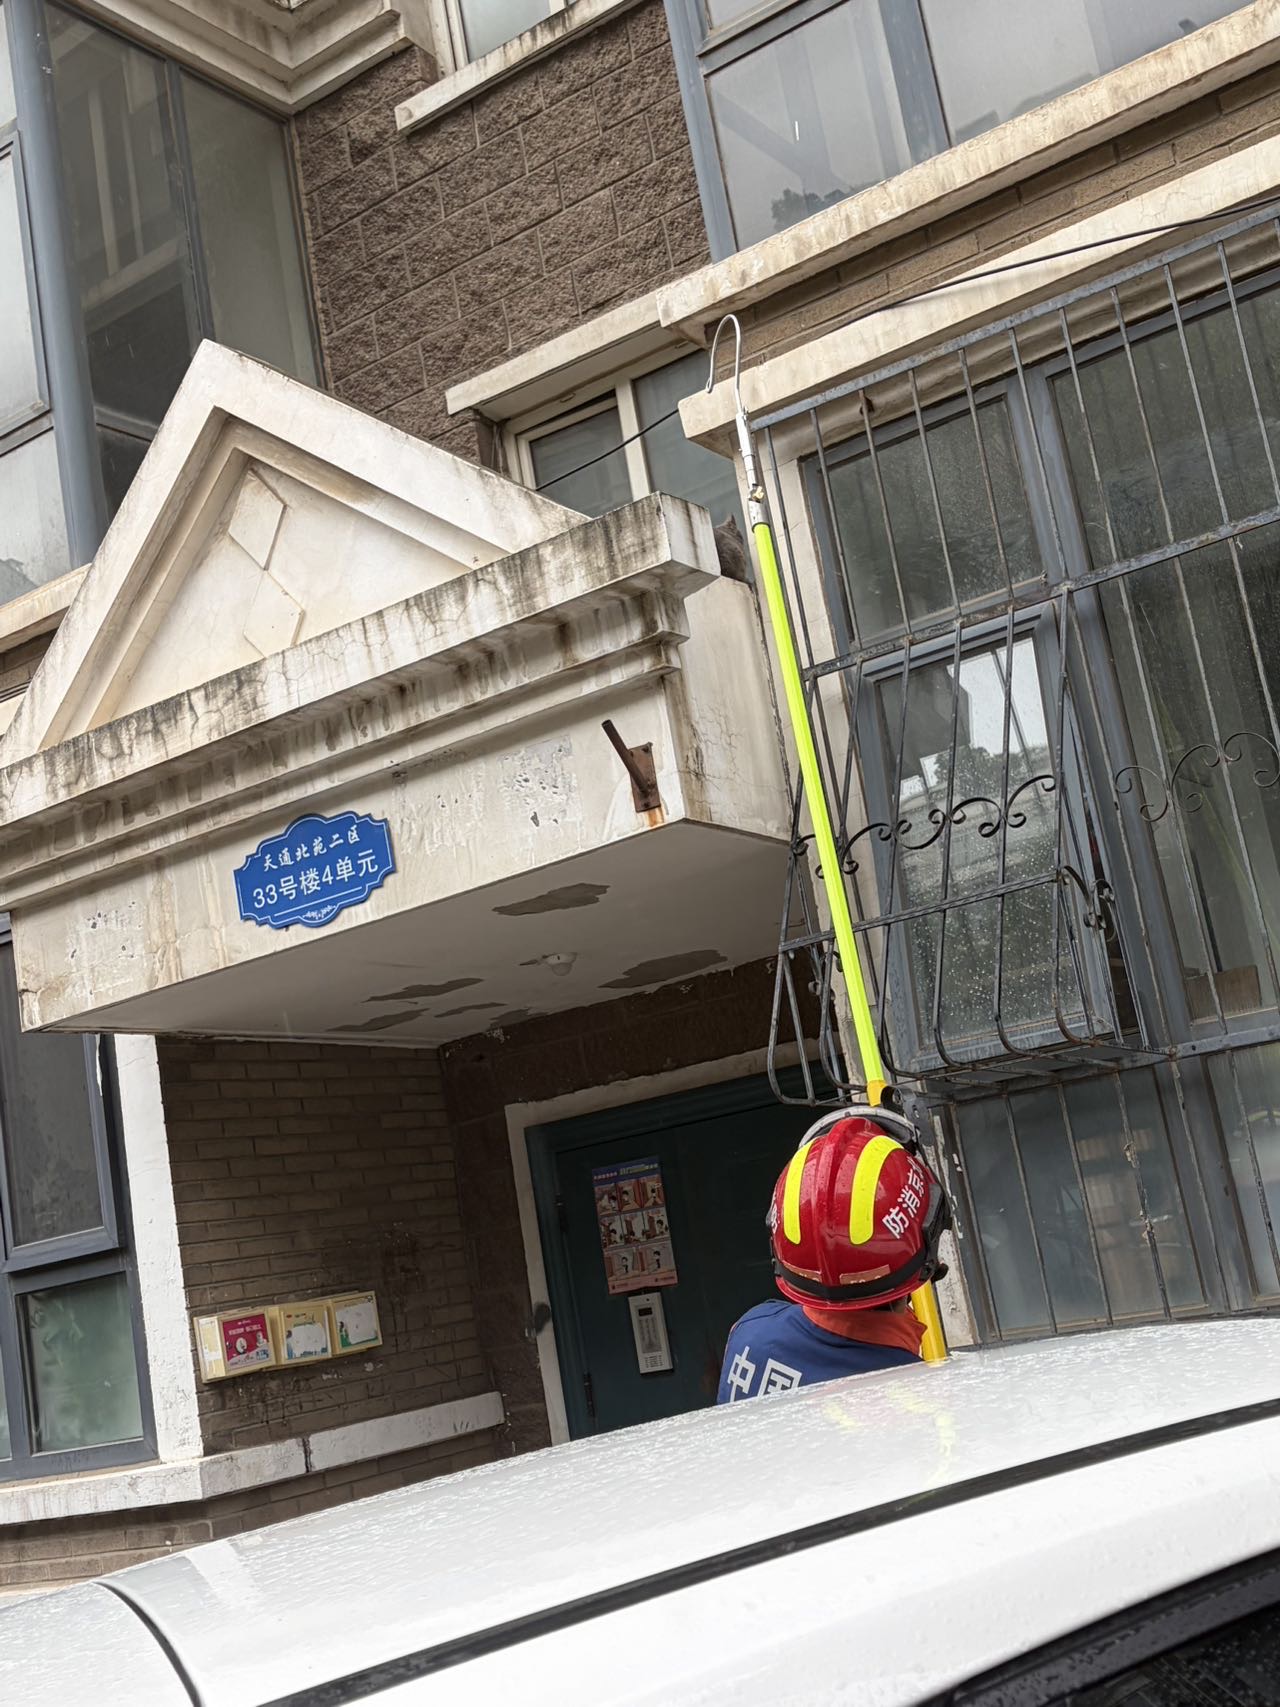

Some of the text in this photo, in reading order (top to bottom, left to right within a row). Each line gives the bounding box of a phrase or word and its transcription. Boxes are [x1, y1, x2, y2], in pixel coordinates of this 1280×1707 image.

[264, 825, 360, 872] 天通北苑二区
[253, 849, 378, 908] 33号楼4单元
